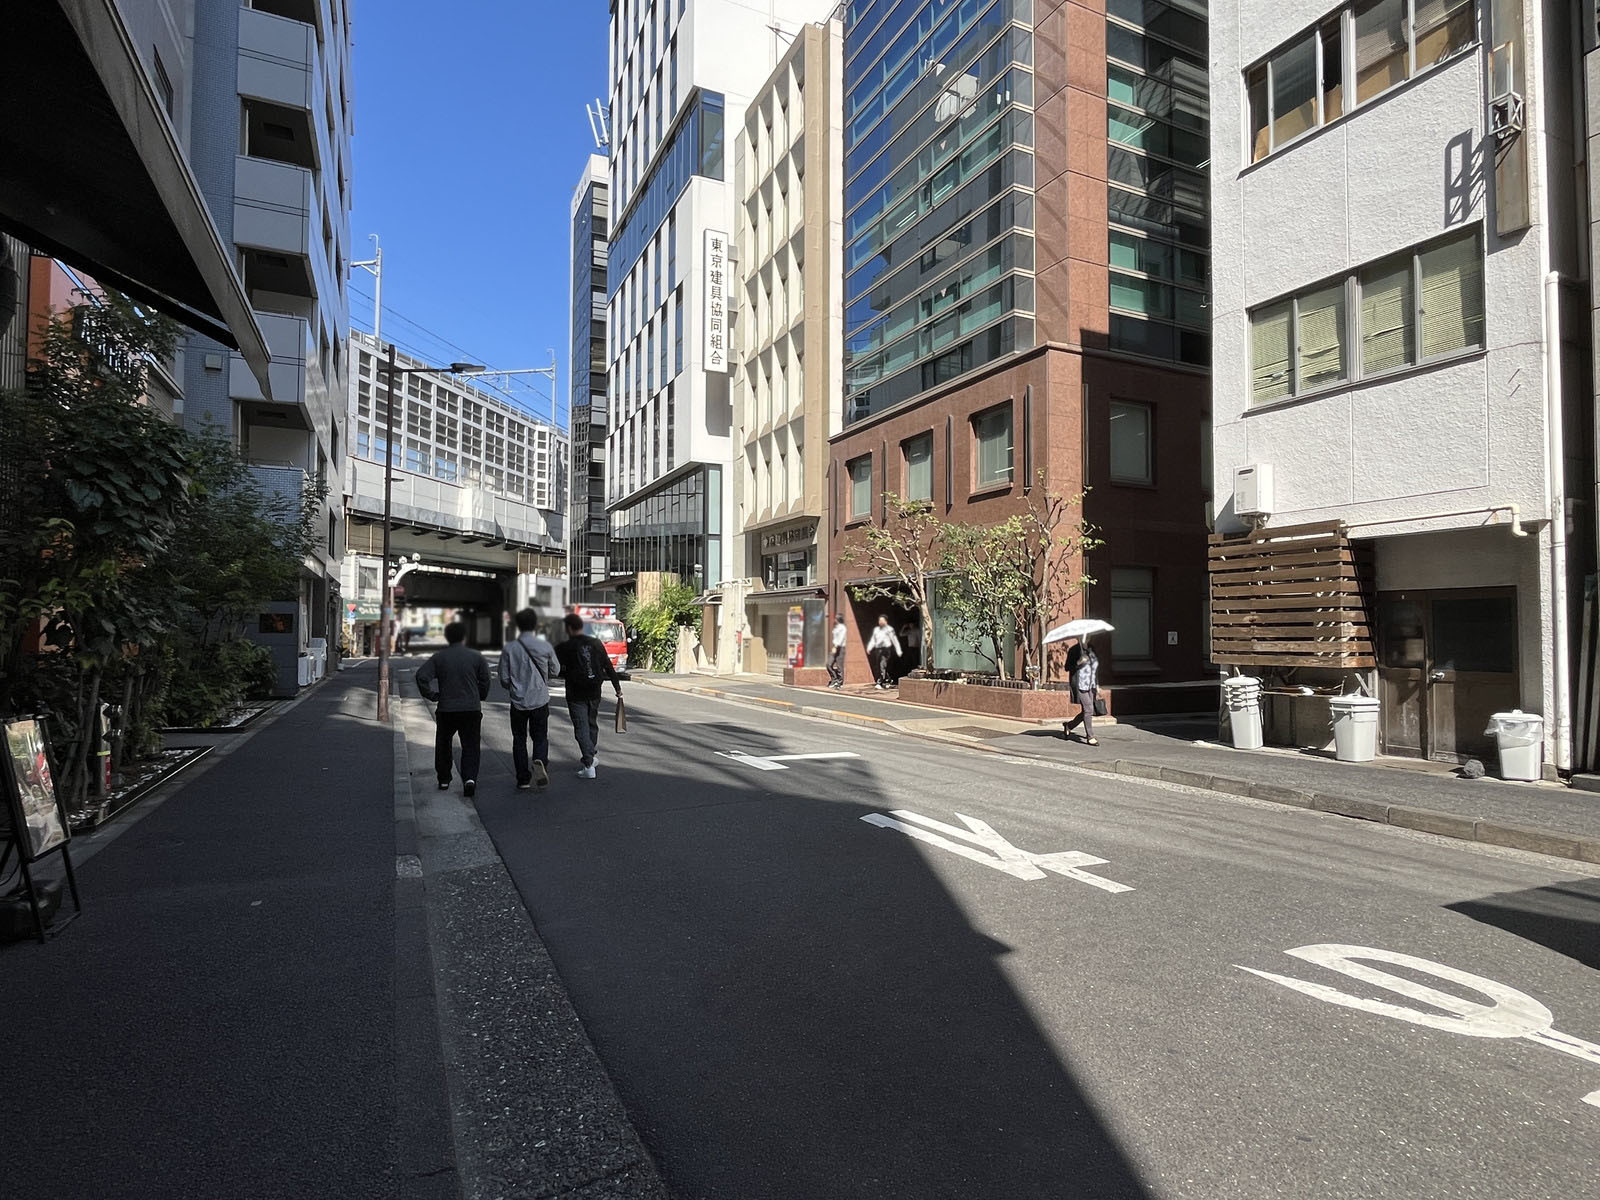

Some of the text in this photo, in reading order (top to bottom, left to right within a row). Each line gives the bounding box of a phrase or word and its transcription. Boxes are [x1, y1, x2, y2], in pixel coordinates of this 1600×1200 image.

[710, 237, 723, 366] 東京建具協同組合
